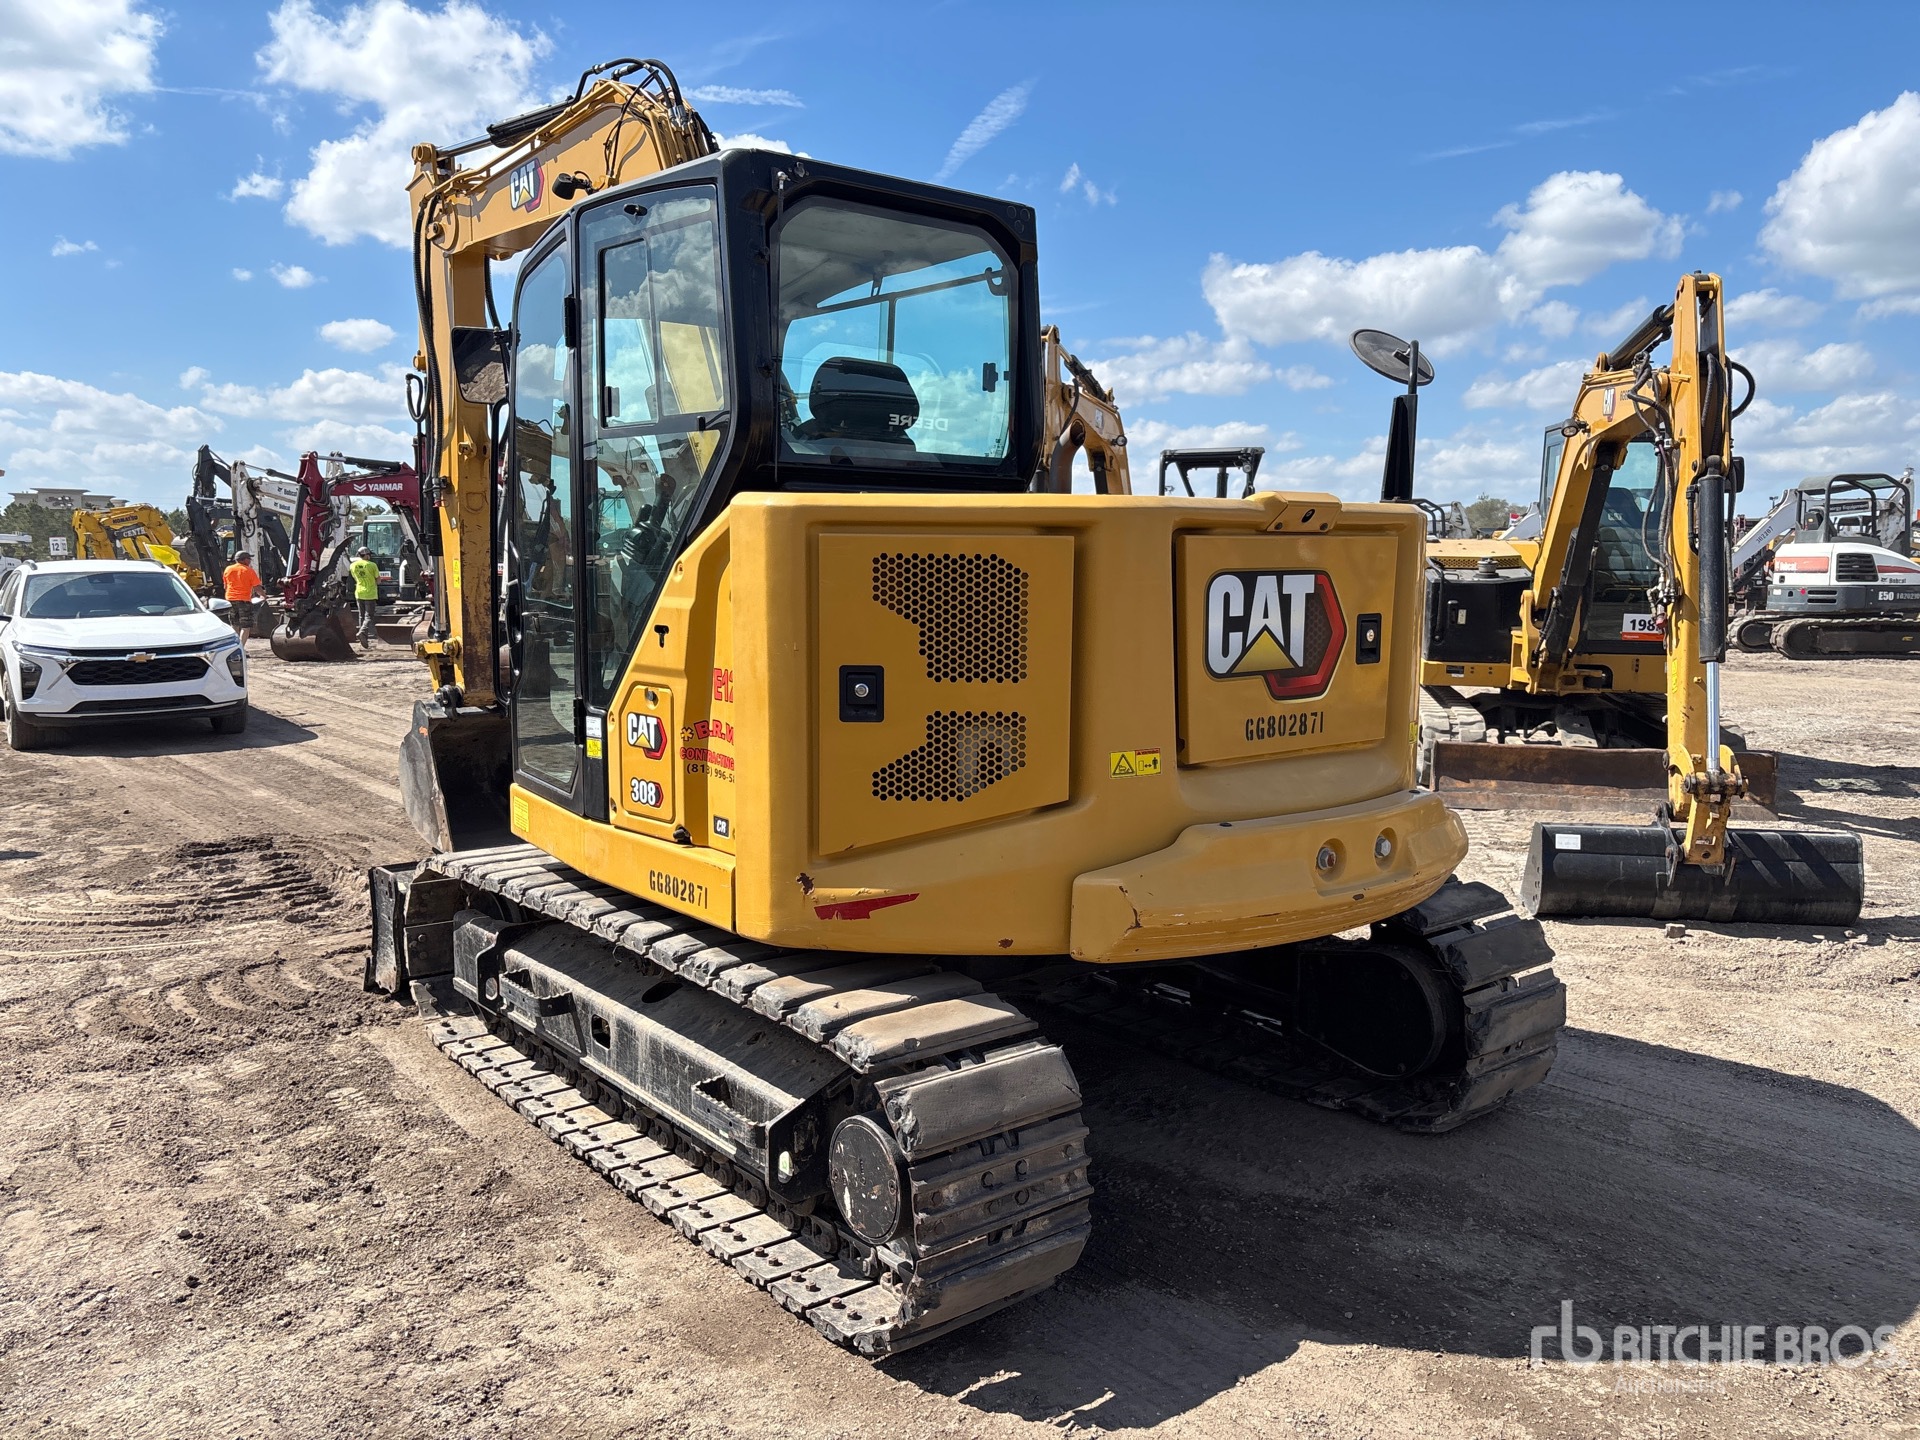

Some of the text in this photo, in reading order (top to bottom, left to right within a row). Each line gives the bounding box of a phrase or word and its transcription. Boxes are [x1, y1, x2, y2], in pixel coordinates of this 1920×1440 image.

[510, 160, 535, 209] CAT
[368, 482, 403, 492] YANMAR
[51, 542, 60, 552] 12
[1878, 591, 1895, 601] E50
[1208, 573, 1315, 675] CAT
[1629, 618, 1659, 632] 198
[627, 712, 658, 750] CAT
[1244, 710, 1325, 742] GG802871
[679, 746, 735, 771] CONTRACTING
[686, 763, 713, 777] (813)
[631, 778, 656, 806] 308
[716, 819, 727, 834] CR
[649, 869, 708, 910] GG802871
